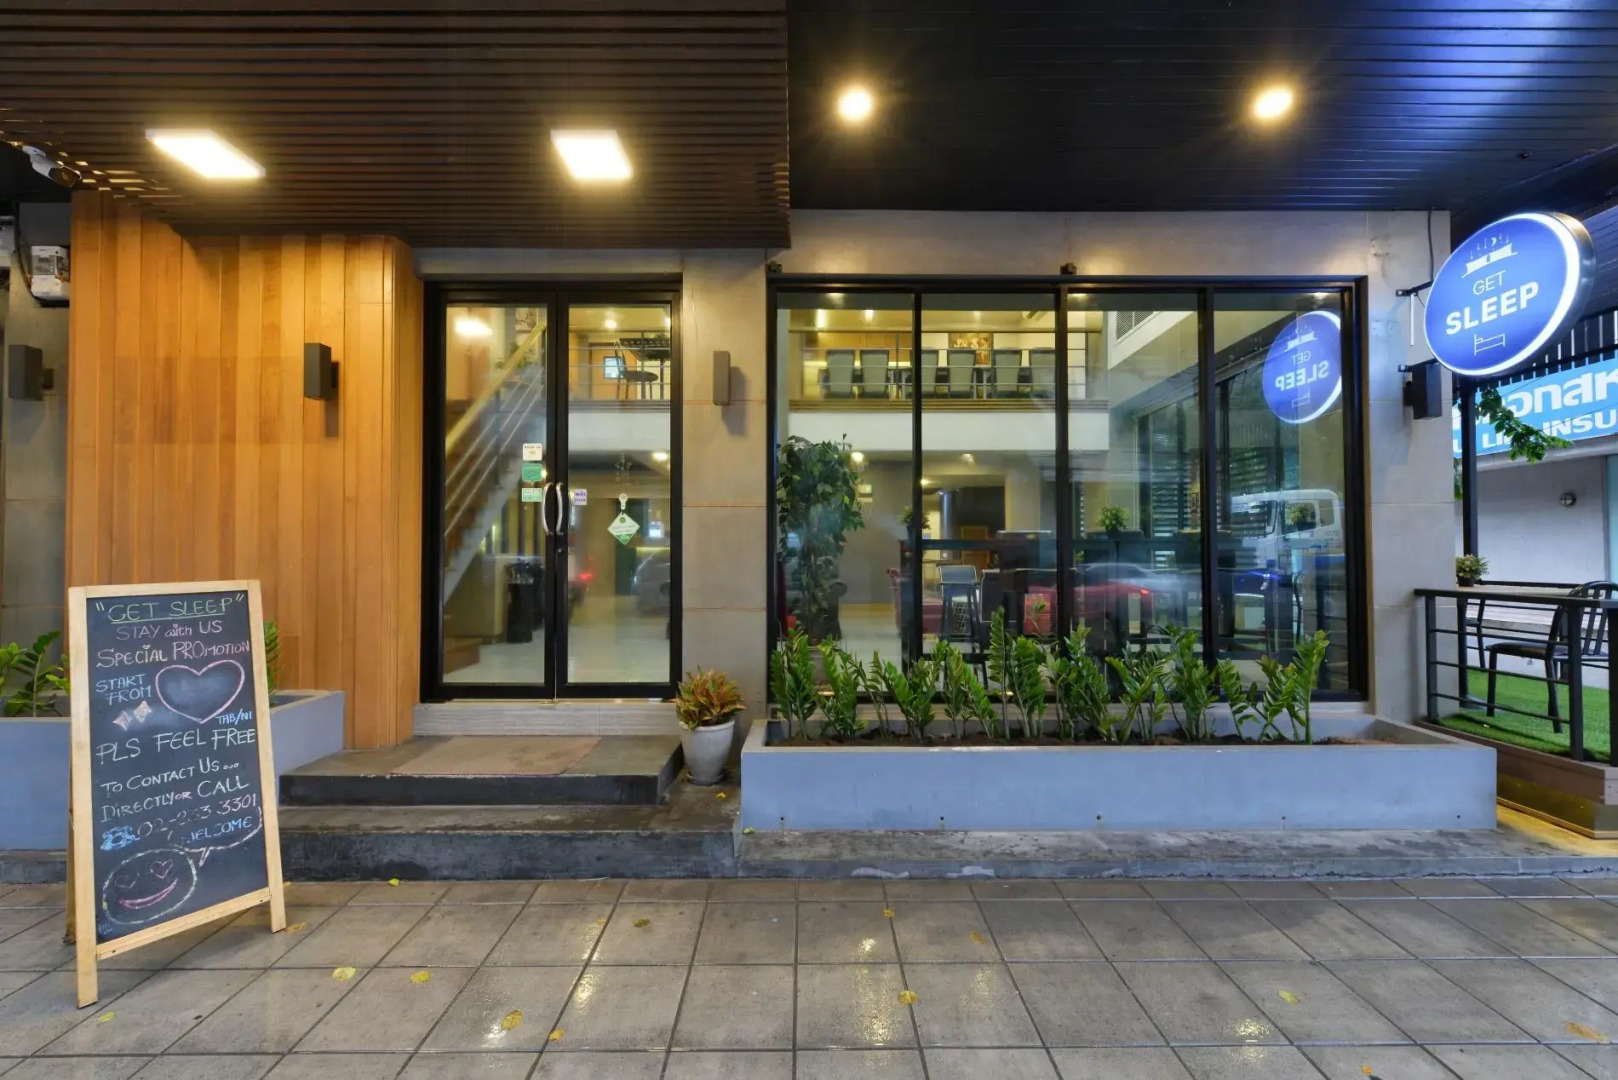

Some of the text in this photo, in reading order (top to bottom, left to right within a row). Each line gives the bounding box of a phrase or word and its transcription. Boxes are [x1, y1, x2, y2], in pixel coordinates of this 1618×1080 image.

[1472, 270, 1506, 296] GET
[1446, 280, 1539, 335] SLEEP
[116, 620, 223, 641] STAY with US
[95, 673, 147, 693] START
[105, 684, 152, 706] FROM
[96, 728, 257, 765] PLS FEEL FREE
[197, 775, 250, 798] CALL
[216, 793, 258, 815] 3301
